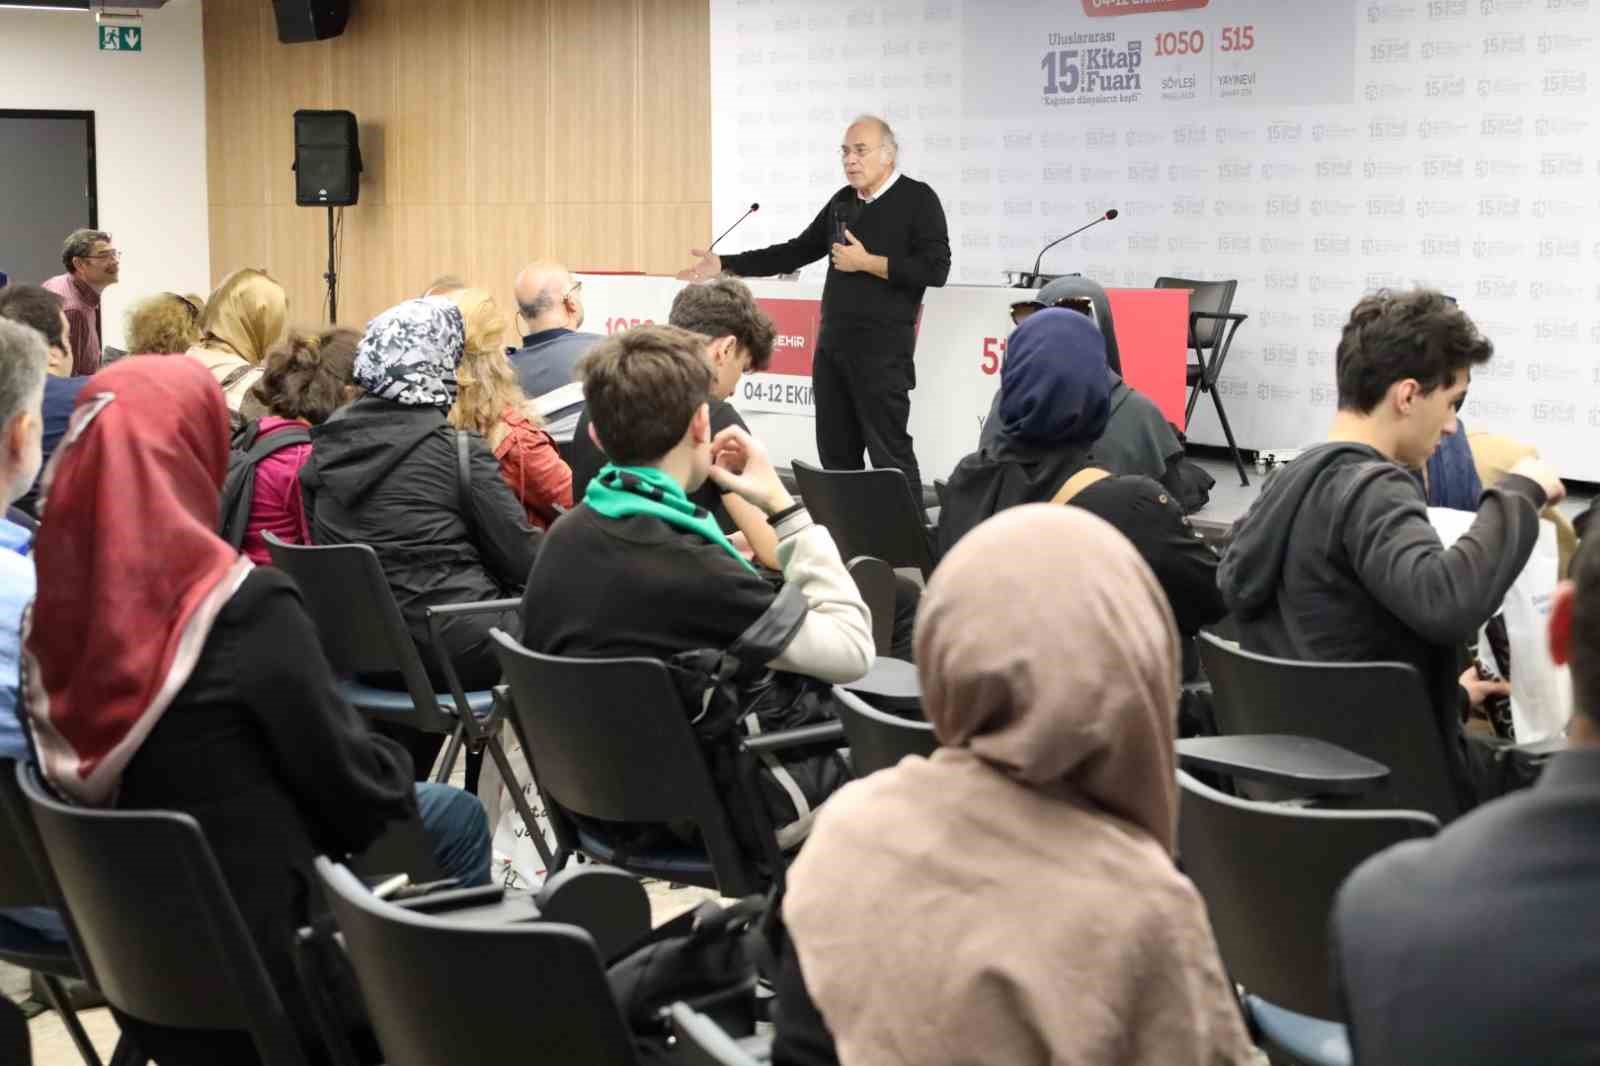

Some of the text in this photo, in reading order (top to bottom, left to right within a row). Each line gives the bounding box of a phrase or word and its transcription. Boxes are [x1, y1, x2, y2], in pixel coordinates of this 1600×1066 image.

[1155, 30, 1204, 56] 1050
[1221, 25, 1254, 52] 515
[1087, 48, 1141, 73] Kitap
[1087, 70, 1141, 92] Fuarı
[744, 381, 782, 402] 04-12
